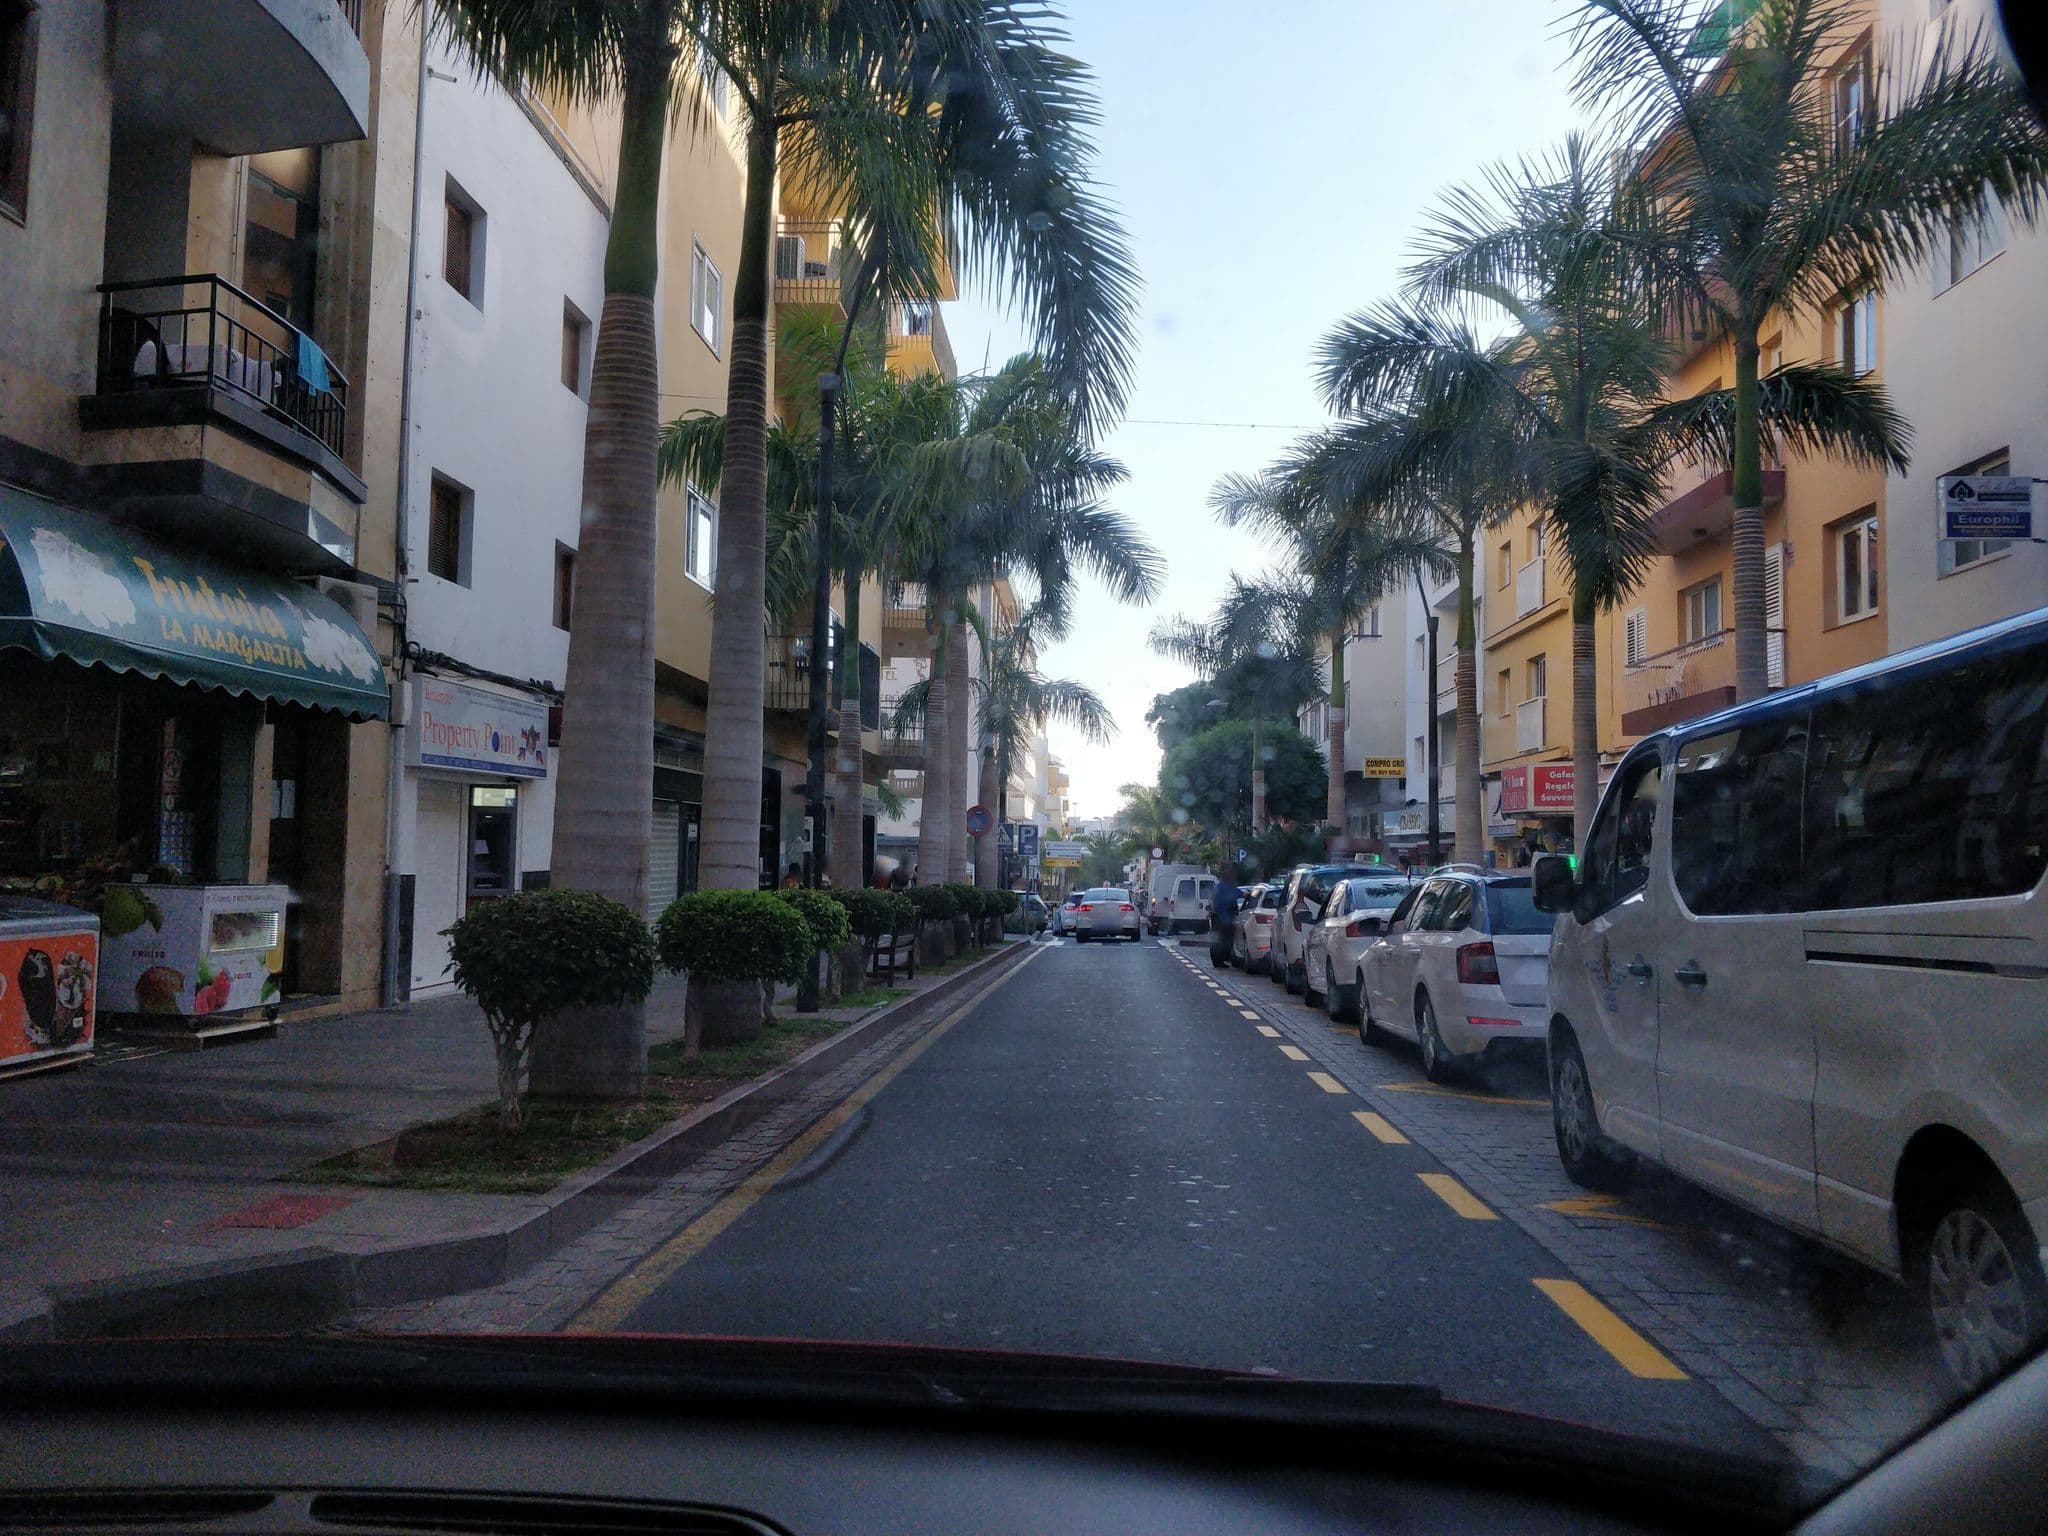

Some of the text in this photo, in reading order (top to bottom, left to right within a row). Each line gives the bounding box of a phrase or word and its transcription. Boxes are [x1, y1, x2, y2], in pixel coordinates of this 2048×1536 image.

[160, 615, 307, 671] LA MARGARITA
[423, 711, 516, 758] Property Point
[1366, 760, 1405, 768] COMPRO ORO
[1021, 826, 1035, 844] P
[1239, 849, 1247, 862] P
